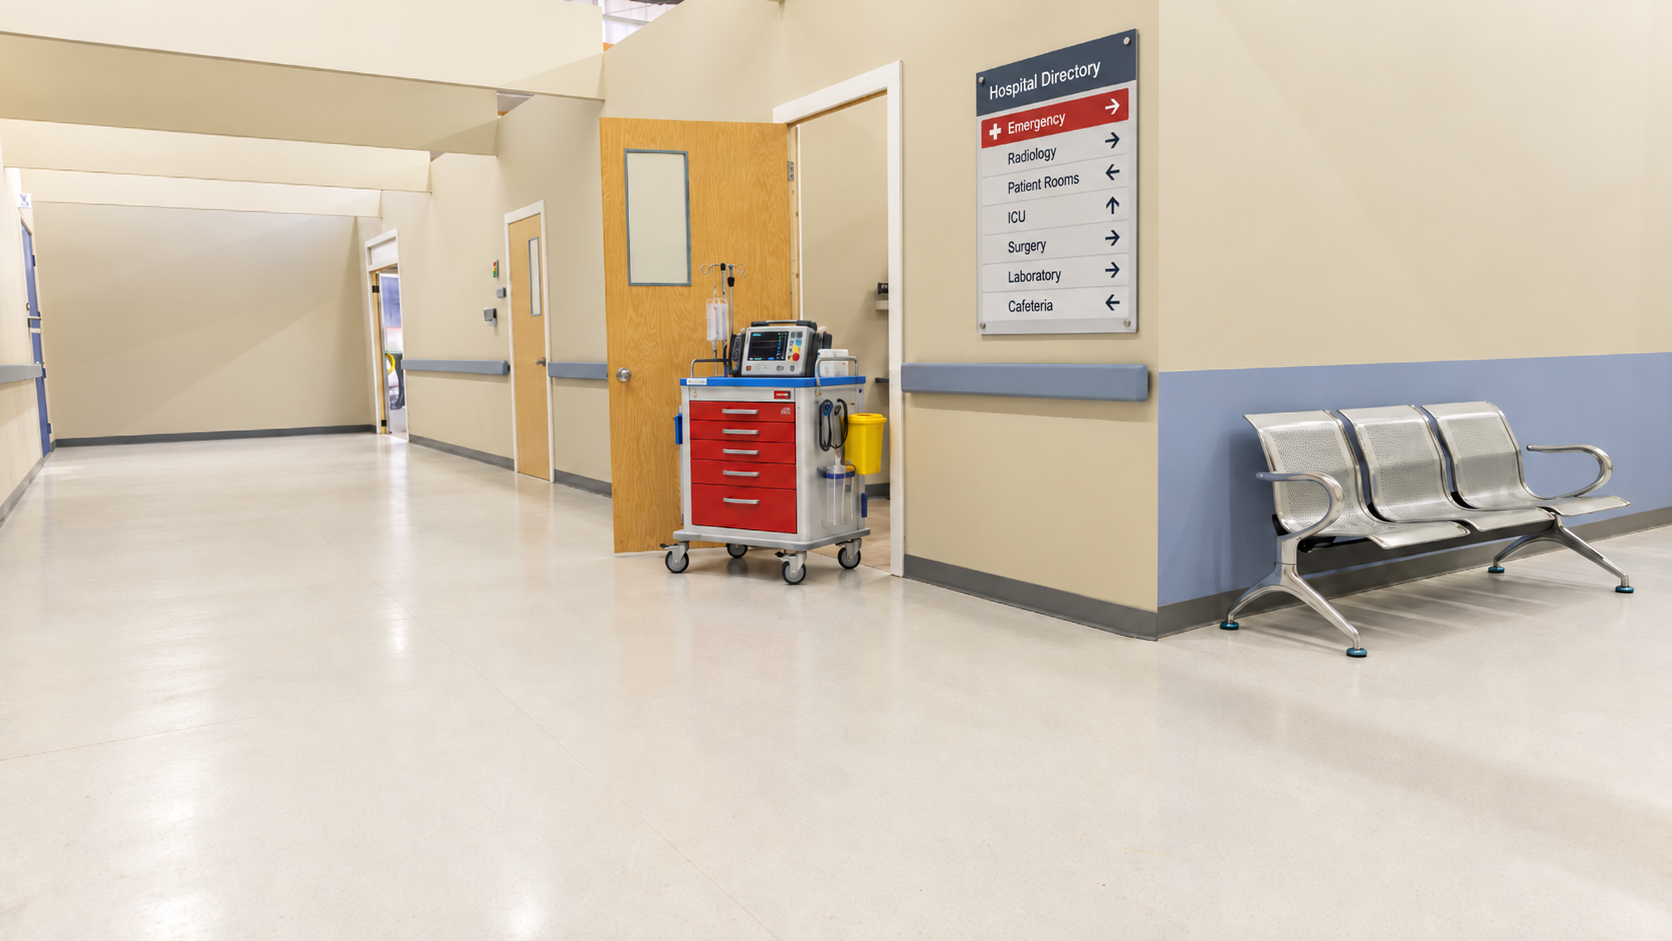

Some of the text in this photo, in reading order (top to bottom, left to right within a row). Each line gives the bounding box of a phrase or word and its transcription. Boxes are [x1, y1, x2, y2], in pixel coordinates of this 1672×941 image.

[989, 60, 1101, 100] Hospital Directory
[1008, 112, 1066, 135] Emergency
[1008, 146, 1057, 165] Radiology
[1008, 174, 1080, 194] Patient Rooms
[1008, 210, 1026, 224] ICU
[1008, 240, 1047, 255] Surgery
[1008, 269, 1062, 284] Laboratory
[1008, 299, 1053, 313] Cafeteria
